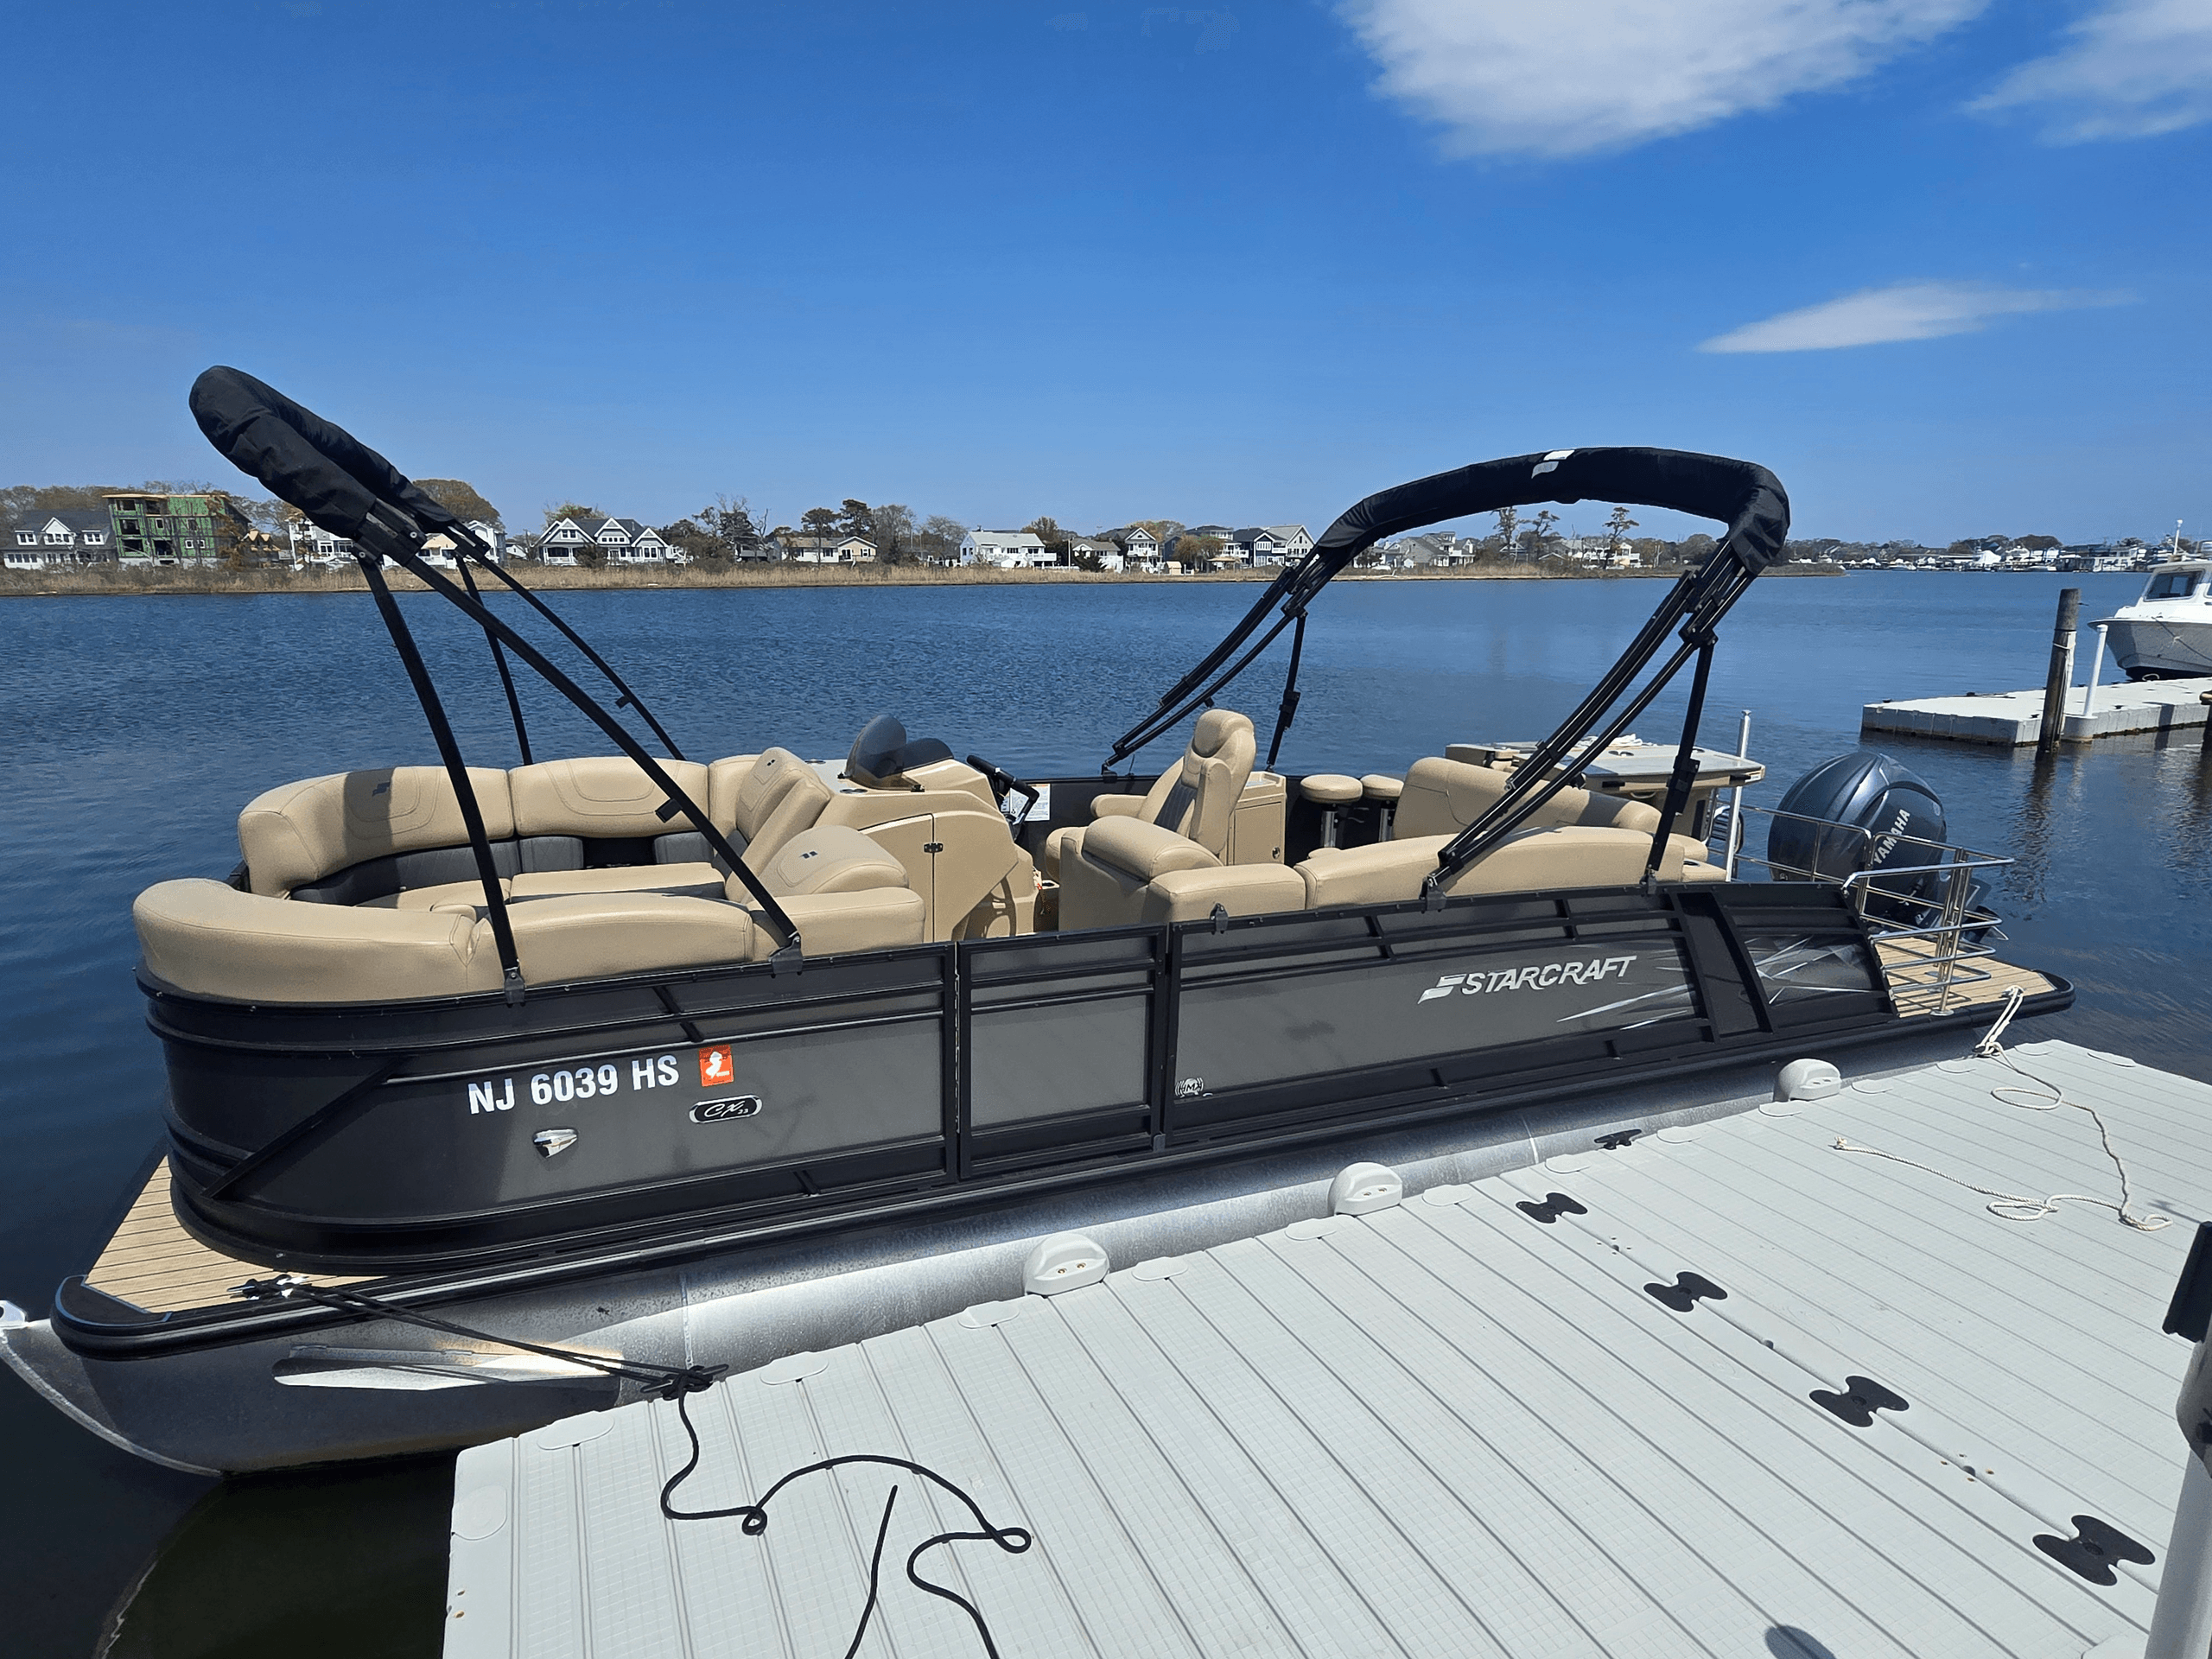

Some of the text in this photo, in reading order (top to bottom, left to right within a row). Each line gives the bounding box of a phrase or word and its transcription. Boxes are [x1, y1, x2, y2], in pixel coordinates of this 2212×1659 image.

[1873, 809, 1910, 864] YAMAHA
[1462, 956, 1637, 995] STARCRAFT
[468, 1055, 680, 1115] NJ 6039 HS
